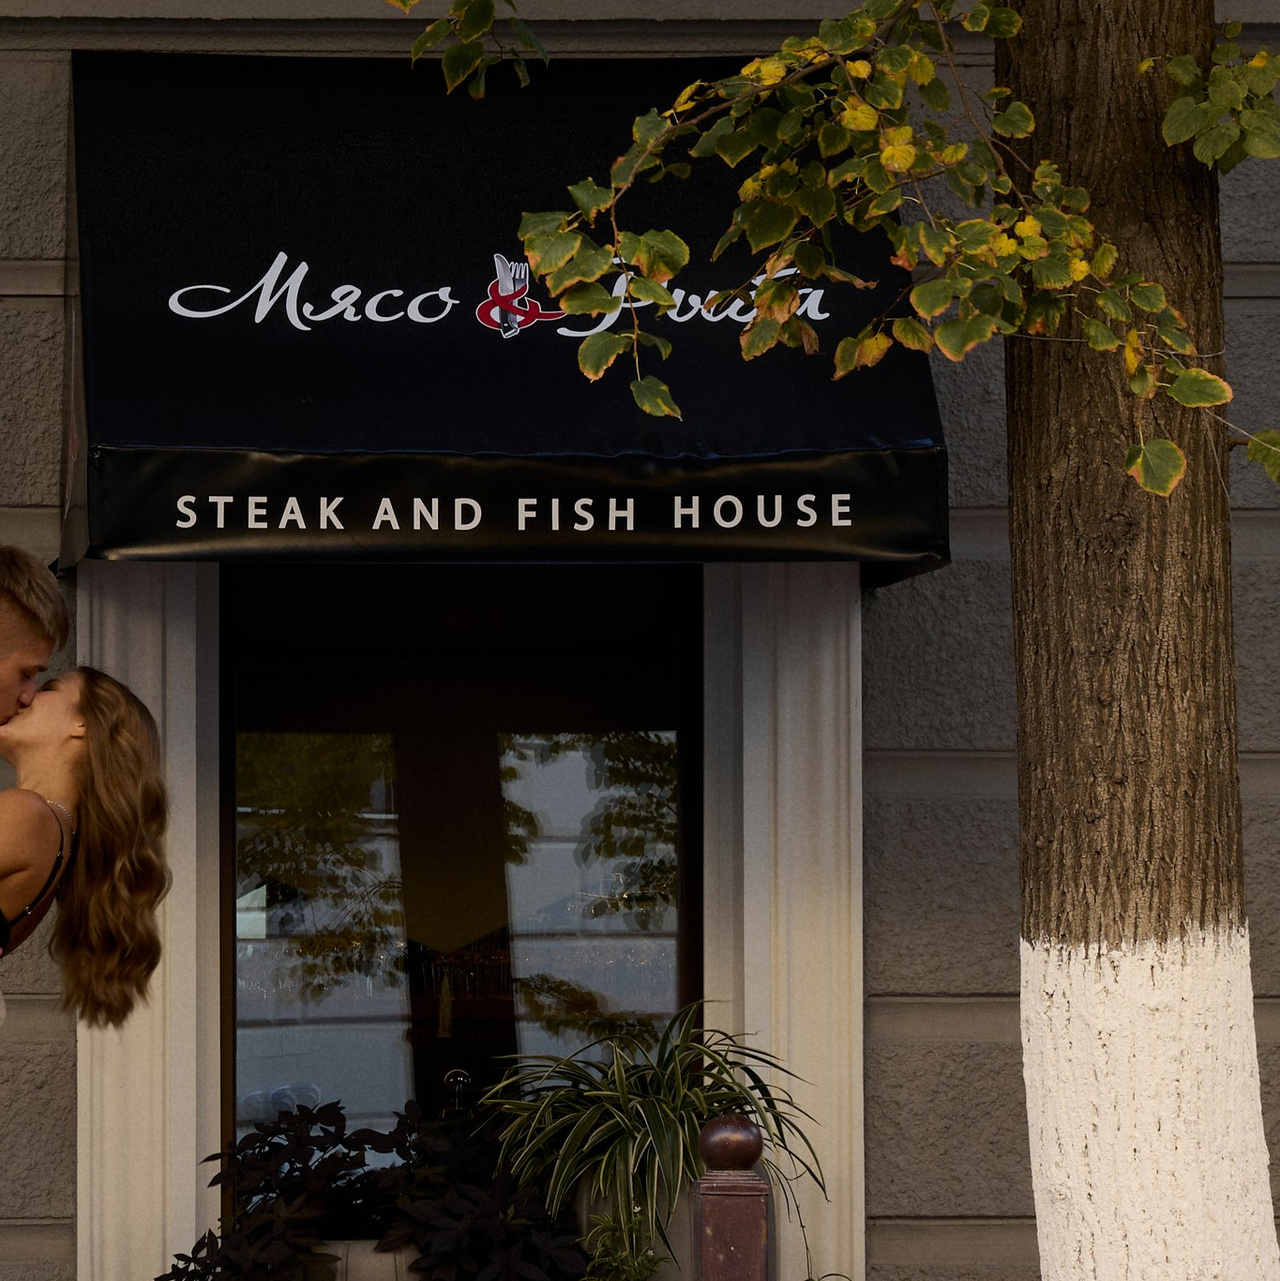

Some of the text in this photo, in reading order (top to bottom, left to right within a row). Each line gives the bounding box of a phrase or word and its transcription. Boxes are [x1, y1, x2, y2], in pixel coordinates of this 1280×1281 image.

[168, 250, 461, 331] Мясо
[175, 493, 853, 532] STEAK AND FISH HOUSE
